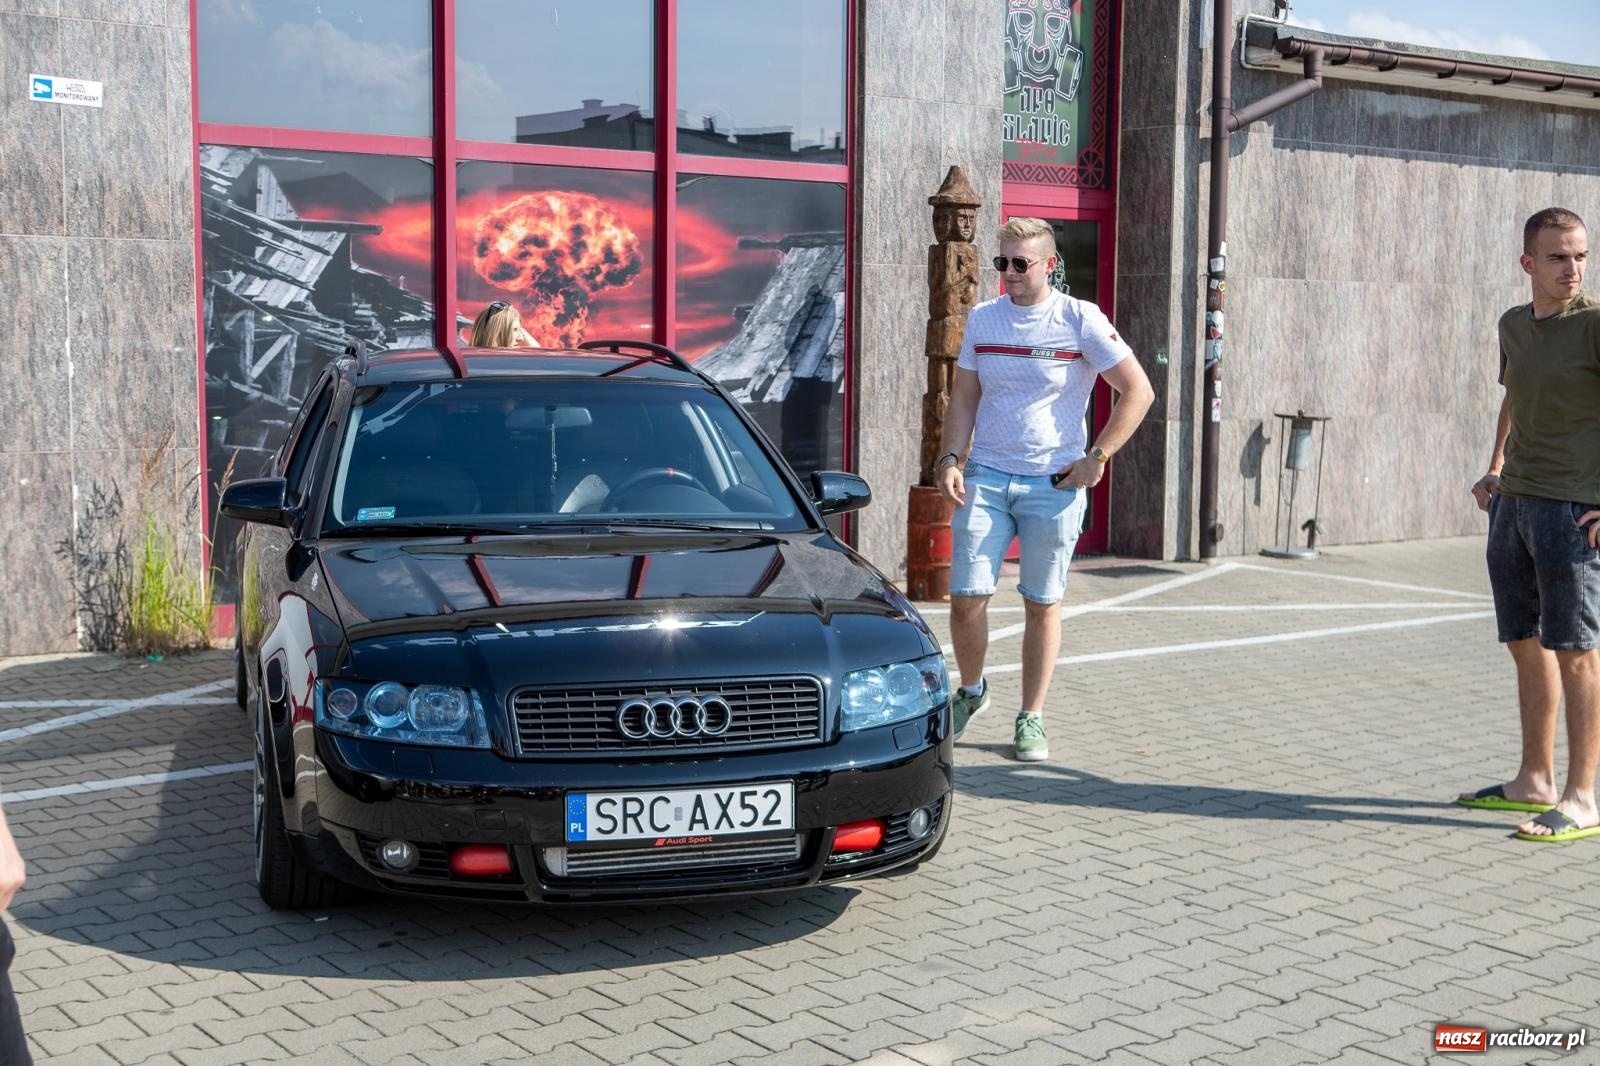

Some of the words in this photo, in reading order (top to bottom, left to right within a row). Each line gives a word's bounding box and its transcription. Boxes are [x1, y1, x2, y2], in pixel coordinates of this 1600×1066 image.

[55, 91, 99, 102] MONITOROWANY
[1031, 349, 1056, 358] GUESS
[595, 795, 672, 835] SRC
[688, 789, 782, 832] AX52
[570, 822, 584, 833] PL
[666, 837, 686, 845] Audi
[688, 836, 713, 844] Sport
